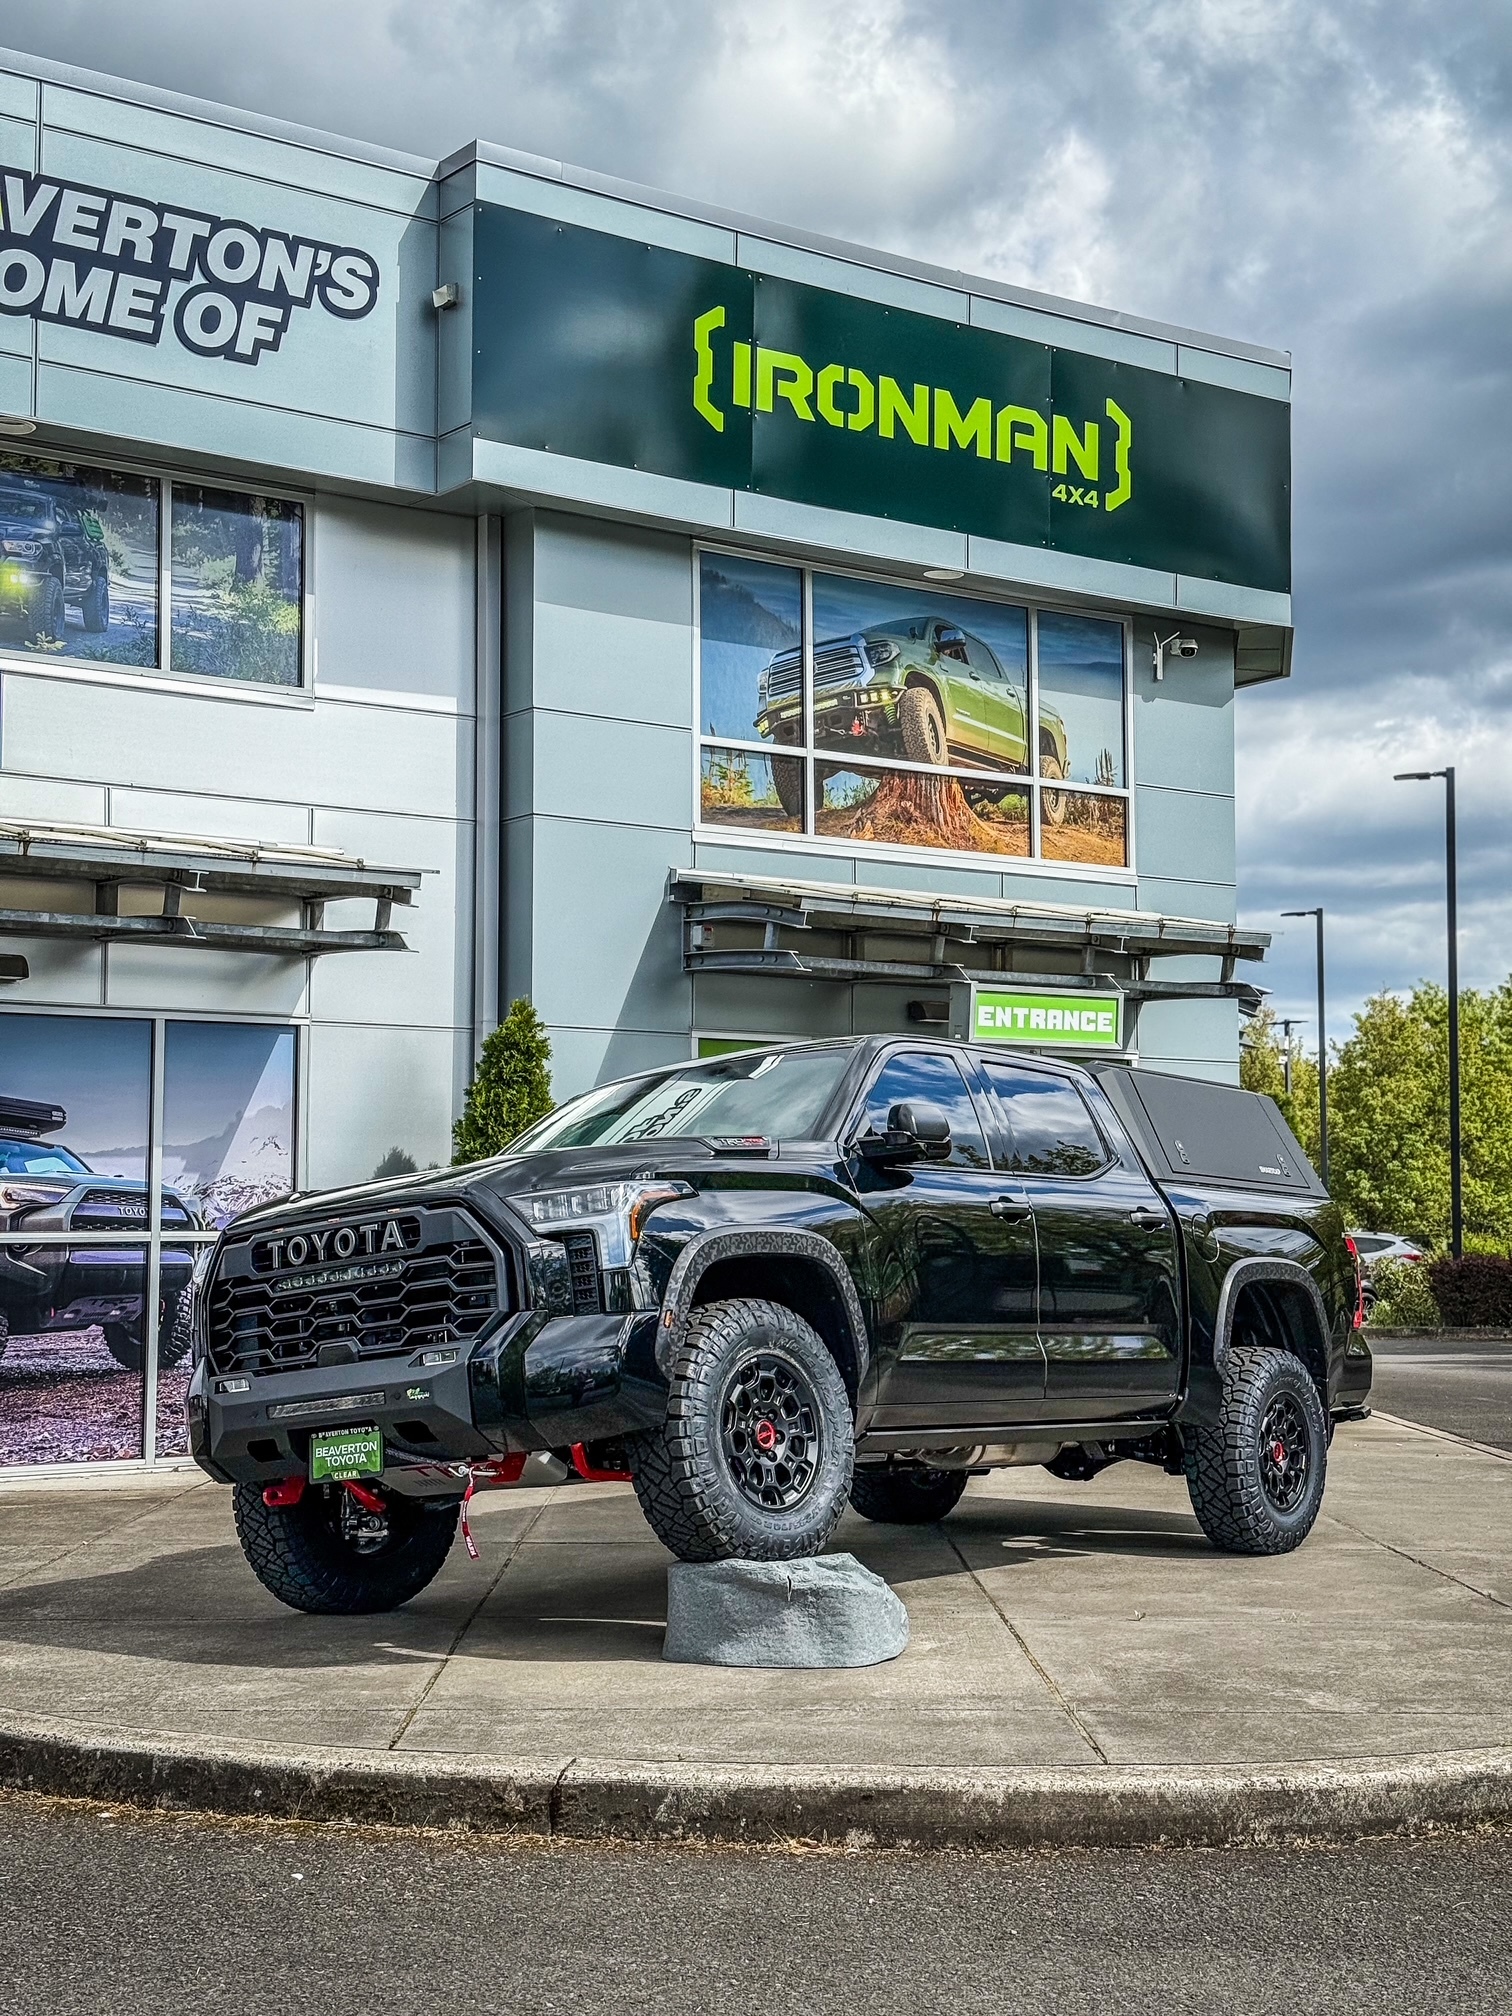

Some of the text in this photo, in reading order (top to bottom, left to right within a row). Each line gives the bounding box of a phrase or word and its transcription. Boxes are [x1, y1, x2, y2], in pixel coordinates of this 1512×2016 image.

[0, 175, 373, 311] VERTON'S
[182, 291, 284, 357] OF
[733, 341, 1099, 482] IRONMAN
[1052, 484, 1099, 509] 4X4
[977, 1005, 1113, 1033] ENTRANCE
[118, 1206, 149, 1217] TOYO
[267, 1220, 404, 1269] TOYOTA
[315, 1441, 377, 1458] BEAVERTON
[325, 1453, 367, 1467] TOYOTA
[334, 1471, 357, 1479] CLEAR
